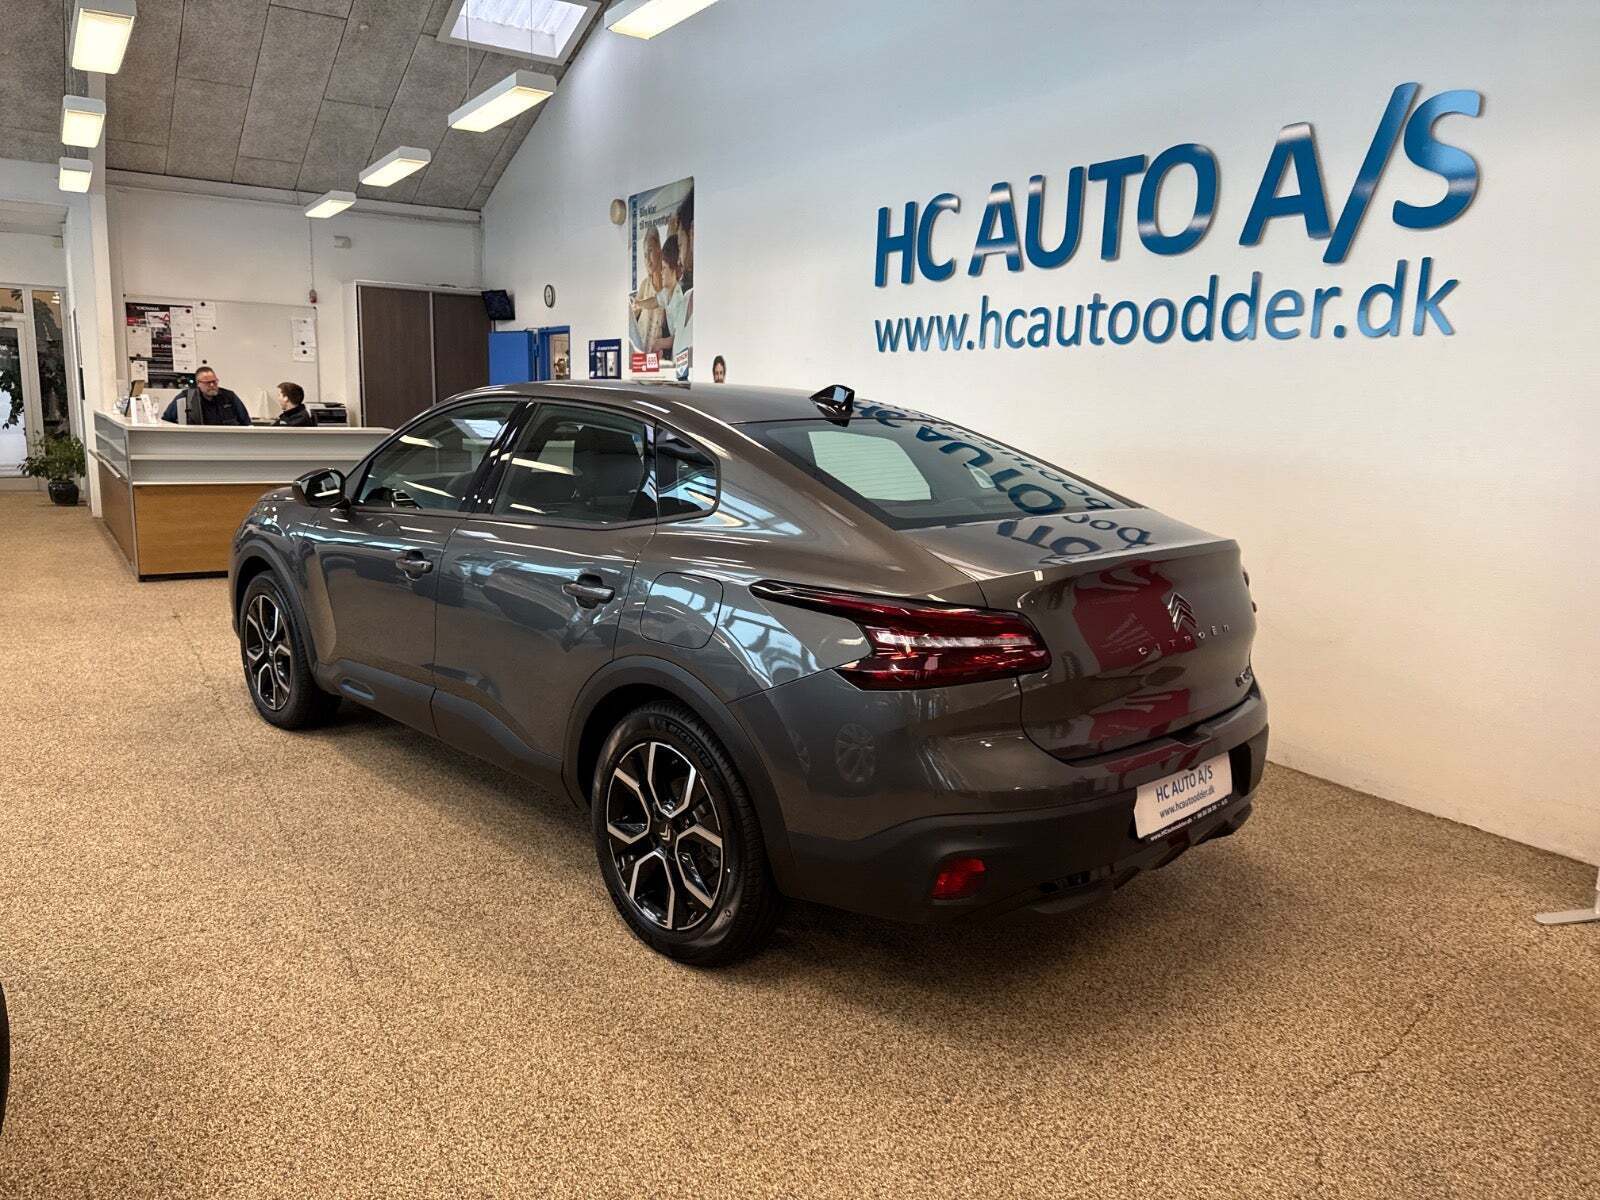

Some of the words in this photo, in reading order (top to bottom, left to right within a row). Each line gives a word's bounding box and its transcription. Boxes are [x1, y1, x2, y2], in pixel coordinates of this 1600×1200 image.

[874, 192, 961, 288] HC
[967, 142, 1220, 277] AUTO
[1238, 81, 1482, 265] A/S
[874, 256, 1460, 354] www.hcautoodder.dk
[1156, 784, 1170, 803] HC
[1172, 772, 1196, 797] AUTO
[1198, 765, 1213, 785] A/S
